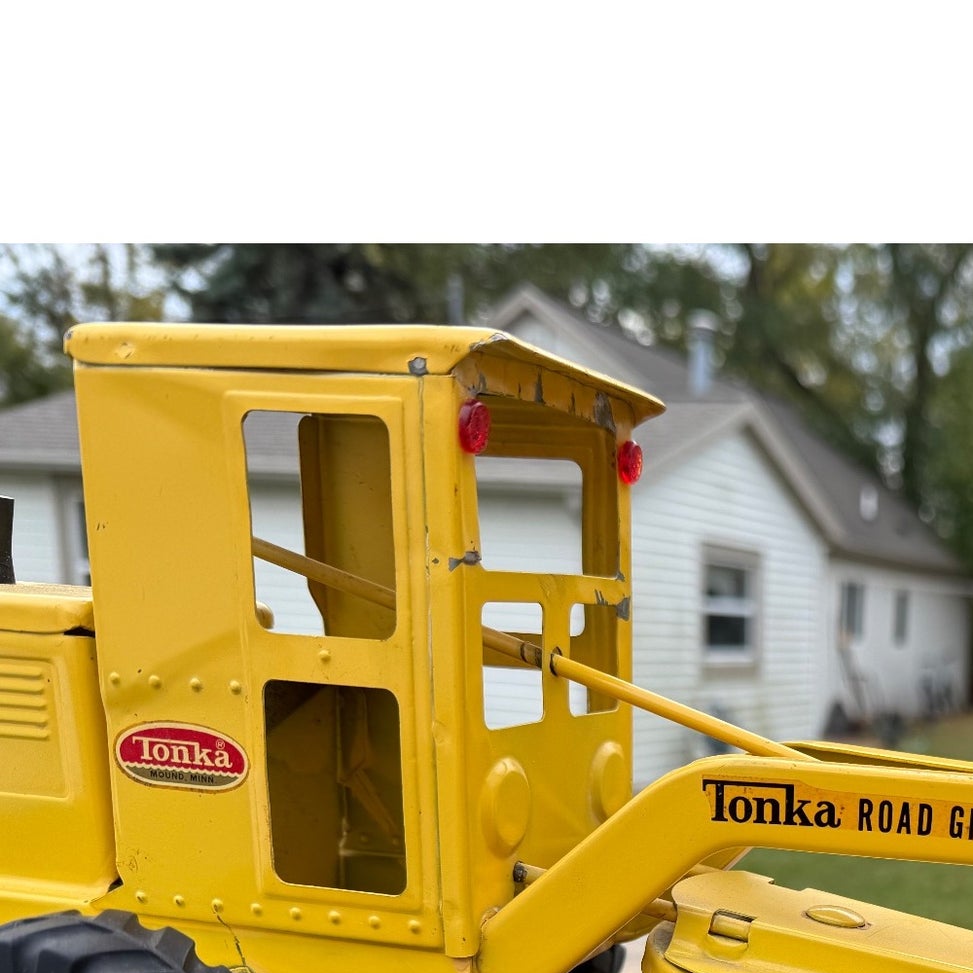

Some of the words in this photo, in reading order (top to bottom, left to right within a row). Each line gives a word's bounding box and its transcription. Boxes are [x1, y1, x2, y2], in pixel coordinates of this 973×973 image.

[132, 736, 233, 768] Tonka
[702, 779, 842, 829] Tonka
[858, 798, 934, 836] ROAD
